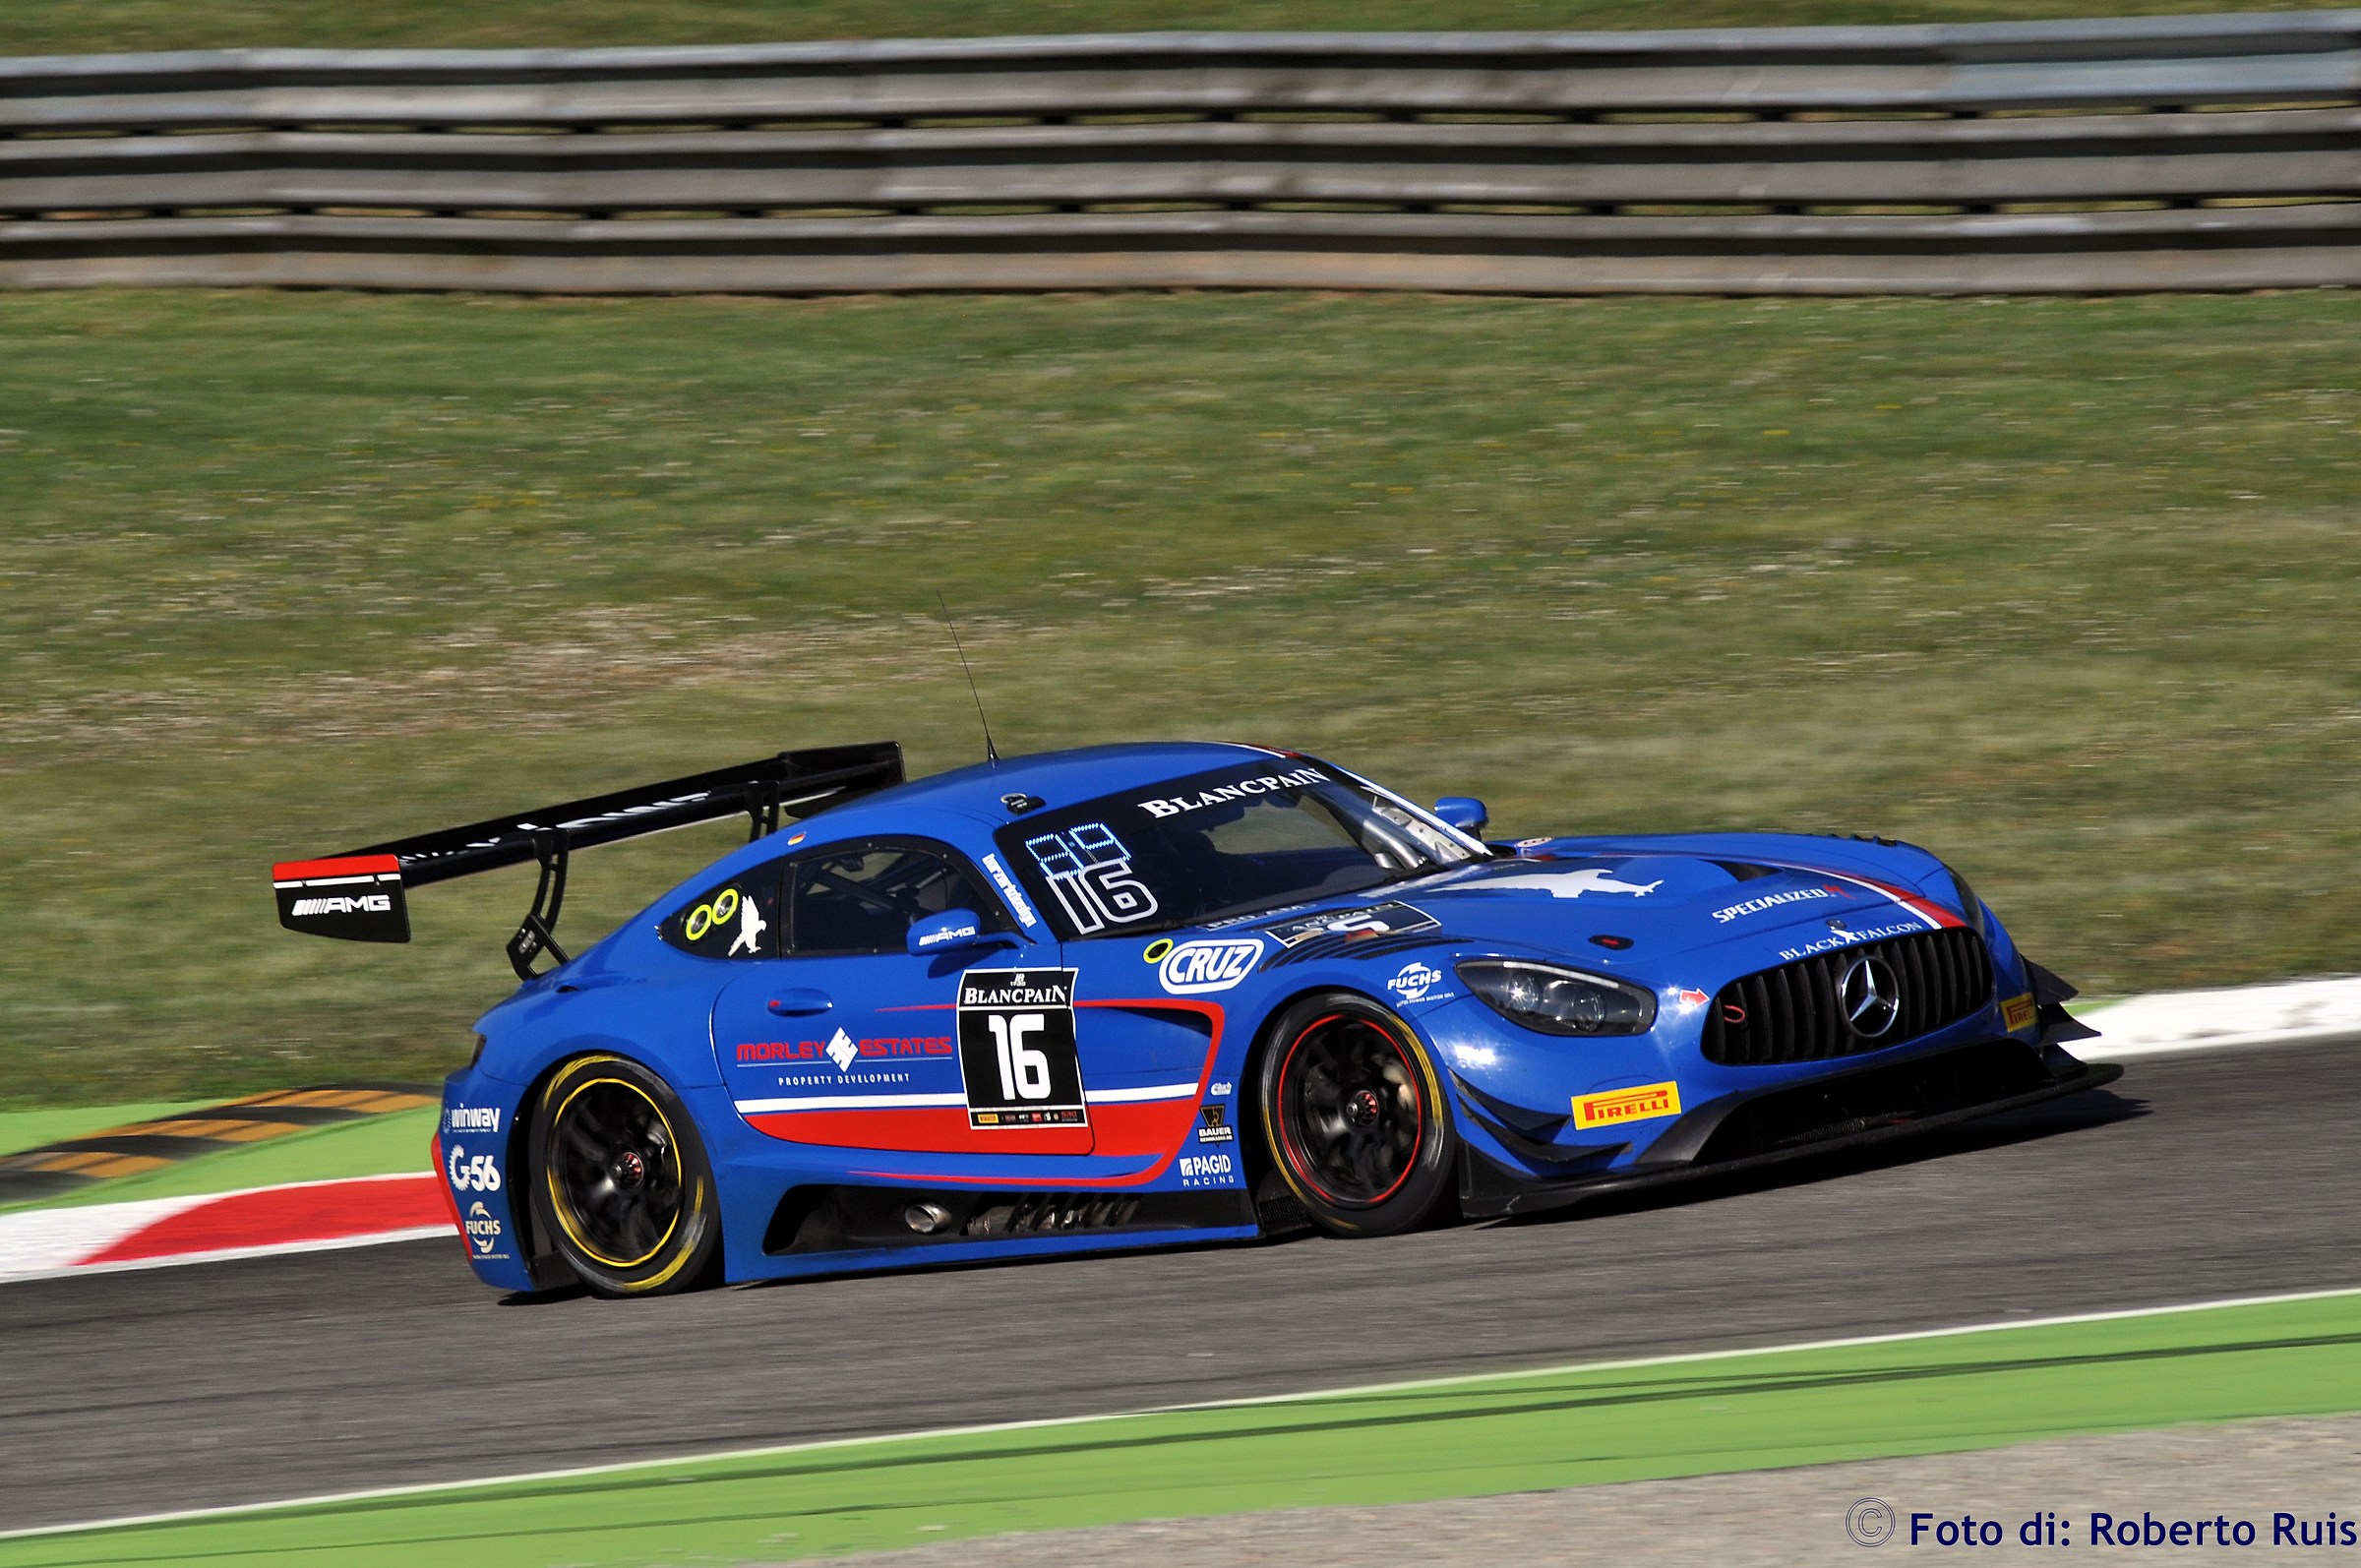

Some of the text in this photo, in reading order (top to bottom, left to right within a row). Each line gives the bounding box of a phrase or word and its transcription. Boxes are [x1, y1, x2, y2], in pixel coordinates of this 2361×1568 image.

[1137, 767, 1332, 818] BLANCPAIN
[327, 895, 392, 914] AMG
[1045, 857, 1159, 935] 16
[1712, 887, 1830, 924] SPECIALIZED
[937, 926, 976, 942] AMG
[1779, 922, 1923, 961] BLACK FALCON
[1168, 945, 1255, 984] CRUZ
[1387, 969, 1442, 991] FUCHS
[964, 985, 1067, 1004] BLANCPAIN
[737, 1036, 953, 1061] MORLEY ESTATES
[988, 1013, 1052, 1101] 16
[778, 1073, 910, 1086] PROPERTY DEVELOPMENT
[452, 1102, 501, 1132] winway
[1583, 1090, 1669, 1121] PIRELLI
[1198, 1126, 1232, 1137] BAUER
[1192, 1154, 1232, 1176] PAGID
[1182, 1175, 1235, 1187] RACING
[465, 1219, 502, 1236] FUCHS
